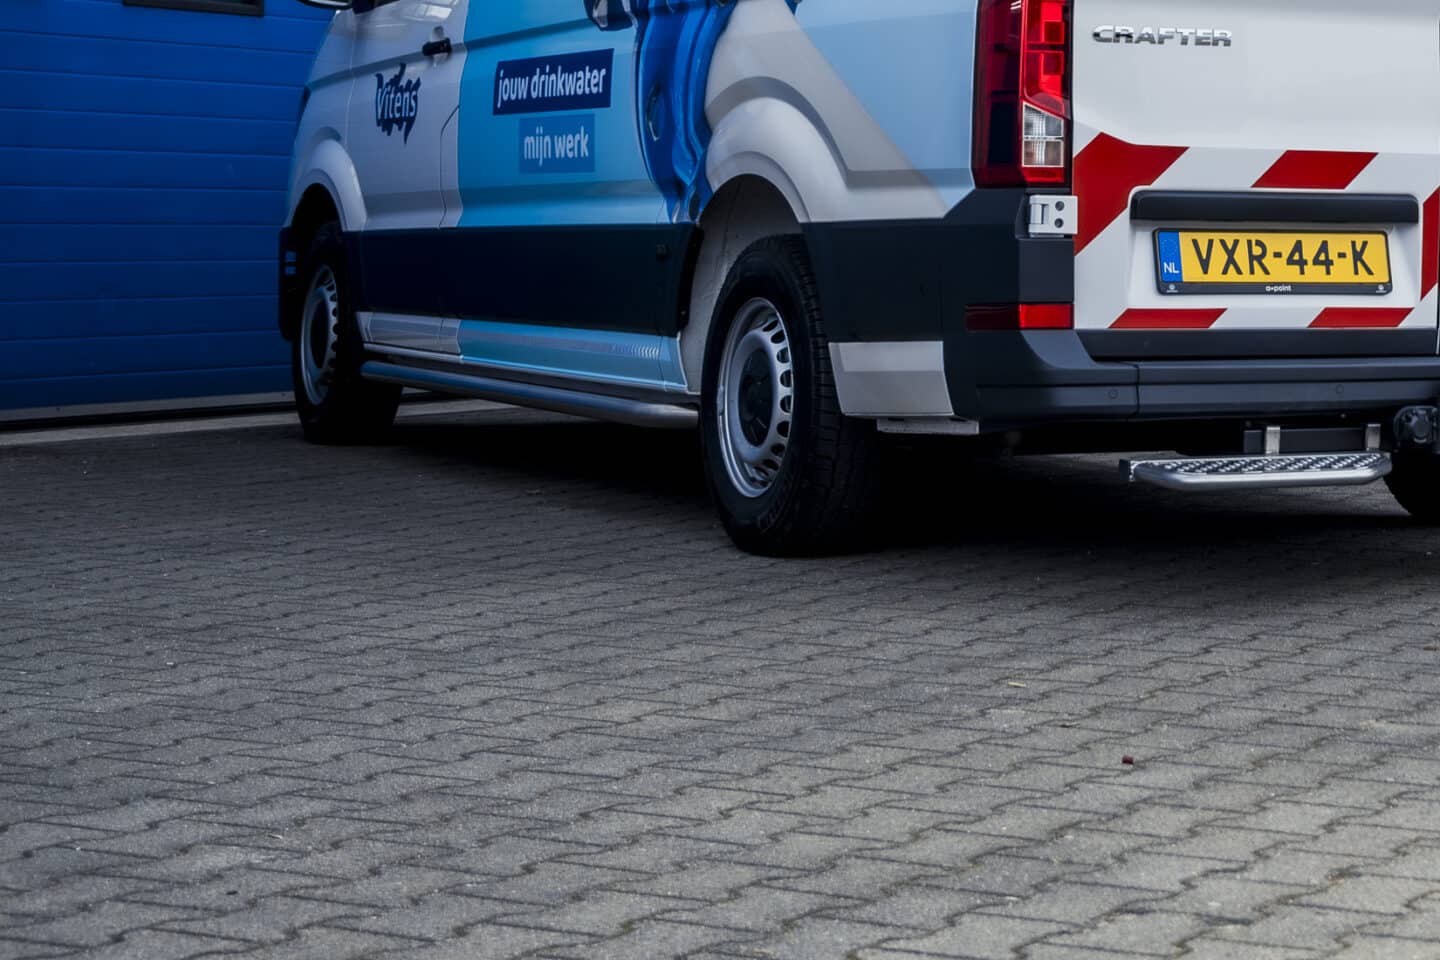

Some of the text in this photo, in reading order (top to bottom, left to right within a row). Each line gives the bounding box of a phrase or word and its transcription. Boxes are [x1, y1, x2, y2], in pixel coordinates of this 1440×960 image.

[1093, 24, 1232, 47] CRAFTER
[497, 65, 607, 109] jouw drinkwater
[523, 126, 589, 166] mijn werk
[1164, 238, 1374, 276] NL VXR-44-K
